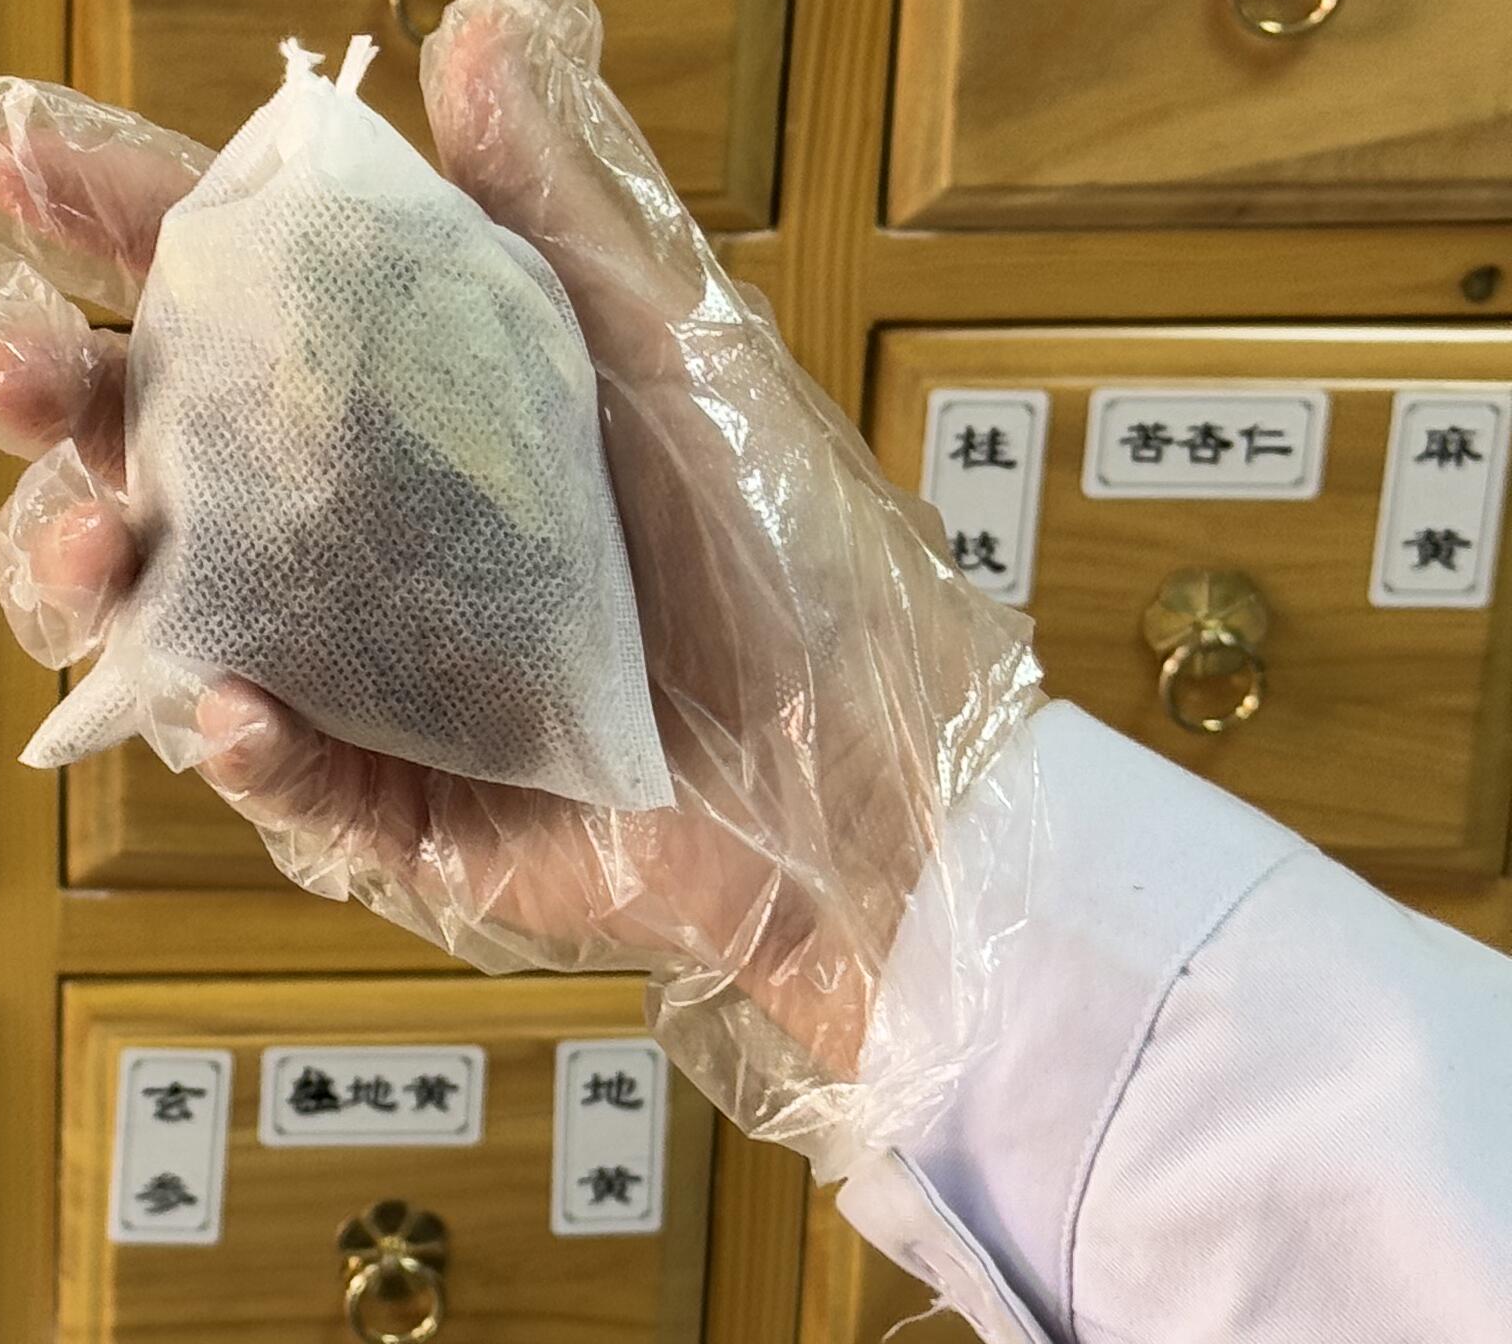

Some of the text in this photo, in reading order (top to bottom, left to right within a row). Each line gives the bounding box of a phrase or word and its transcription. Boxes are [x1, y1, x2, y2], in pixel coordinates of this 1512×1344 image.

[944, 424, 1017, 576] 桂枝
[1118, 420, 1295, 467] 苦杏仁
[1401, 424, 1485, 573] 麻黄
[134, 1079, 209, 1217] 玄参
[286, 1065, 461, 1118] 地黄
[576, 1069, 646, 1206] 地黄
